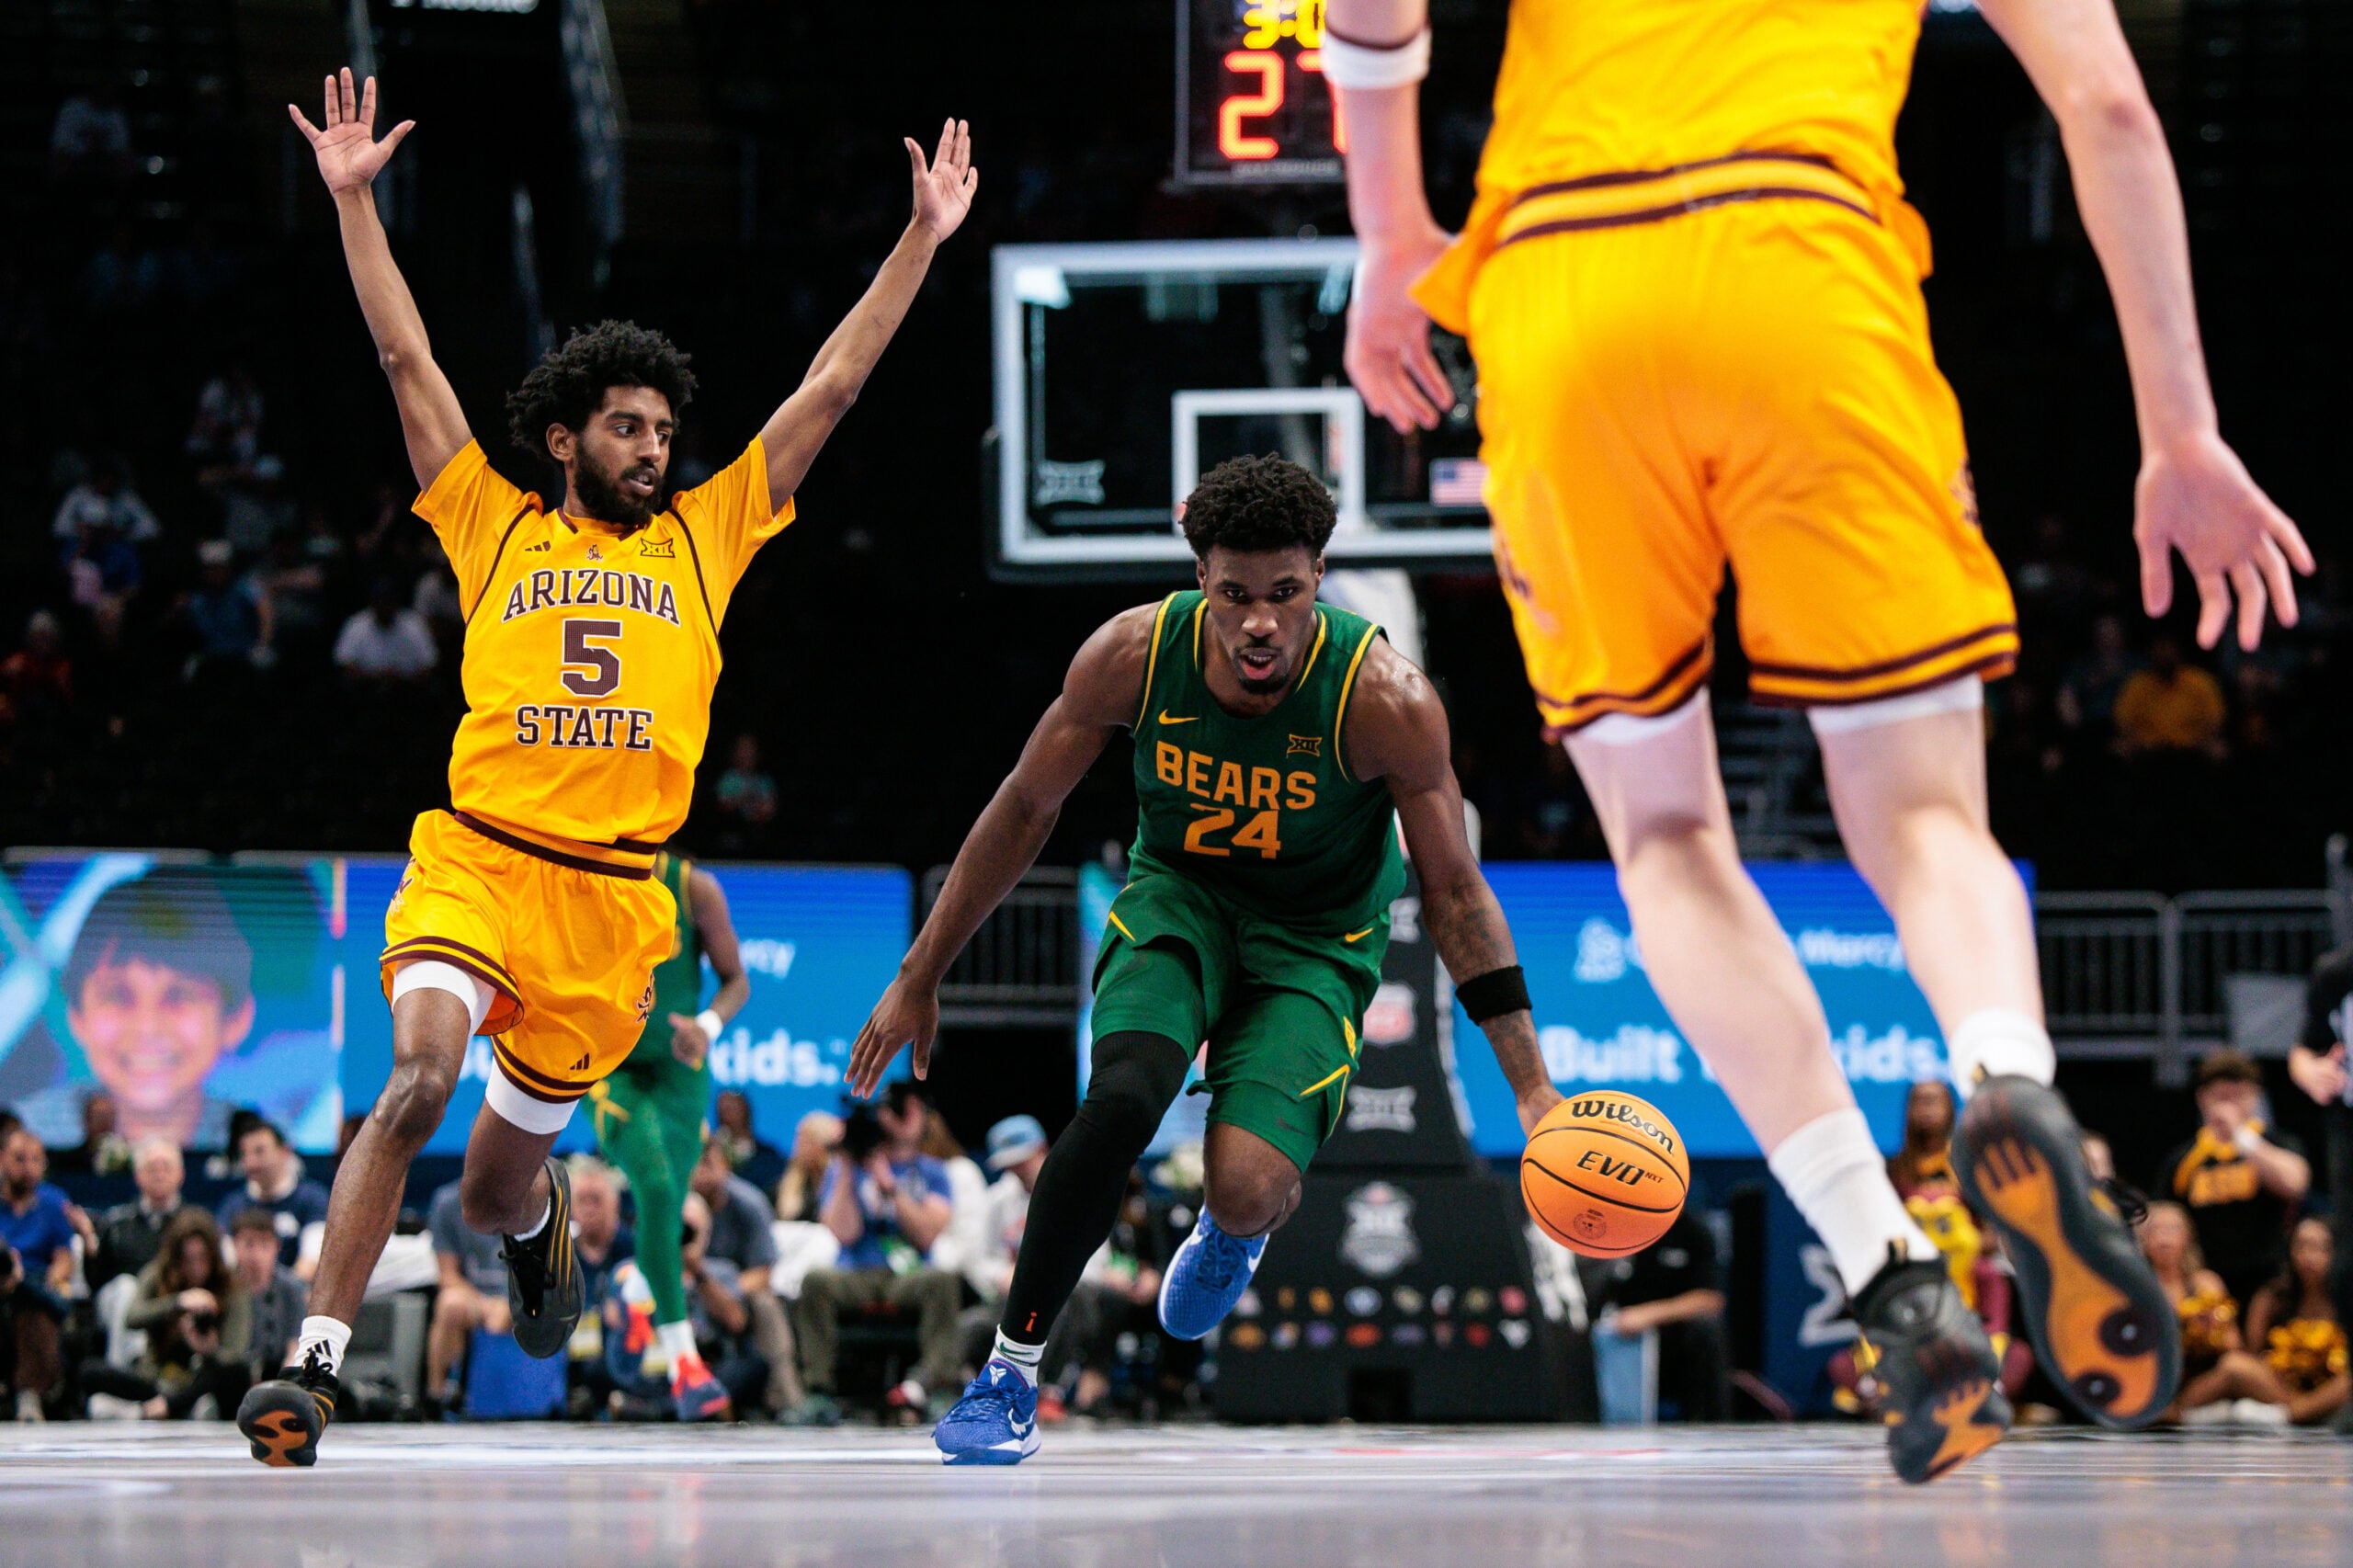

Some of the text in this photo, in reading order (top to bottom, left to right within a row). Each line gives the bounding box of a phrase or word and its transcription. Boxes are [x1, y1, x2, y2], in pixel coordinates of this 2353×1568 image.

[502, 567, 681, 628] ARIZONA
[561, 618, 622, 699] 5
[516, 704, 654, 752] STATE
[1156, 740, 1317, 811] BEARS
[1183, 802, 1281, 860] 24
[1538, 1023, 1684, 1083] Built
[1572, 1099, 1676, 1155] Wilson
[1575, 1150, 1645, 1187] EVO
